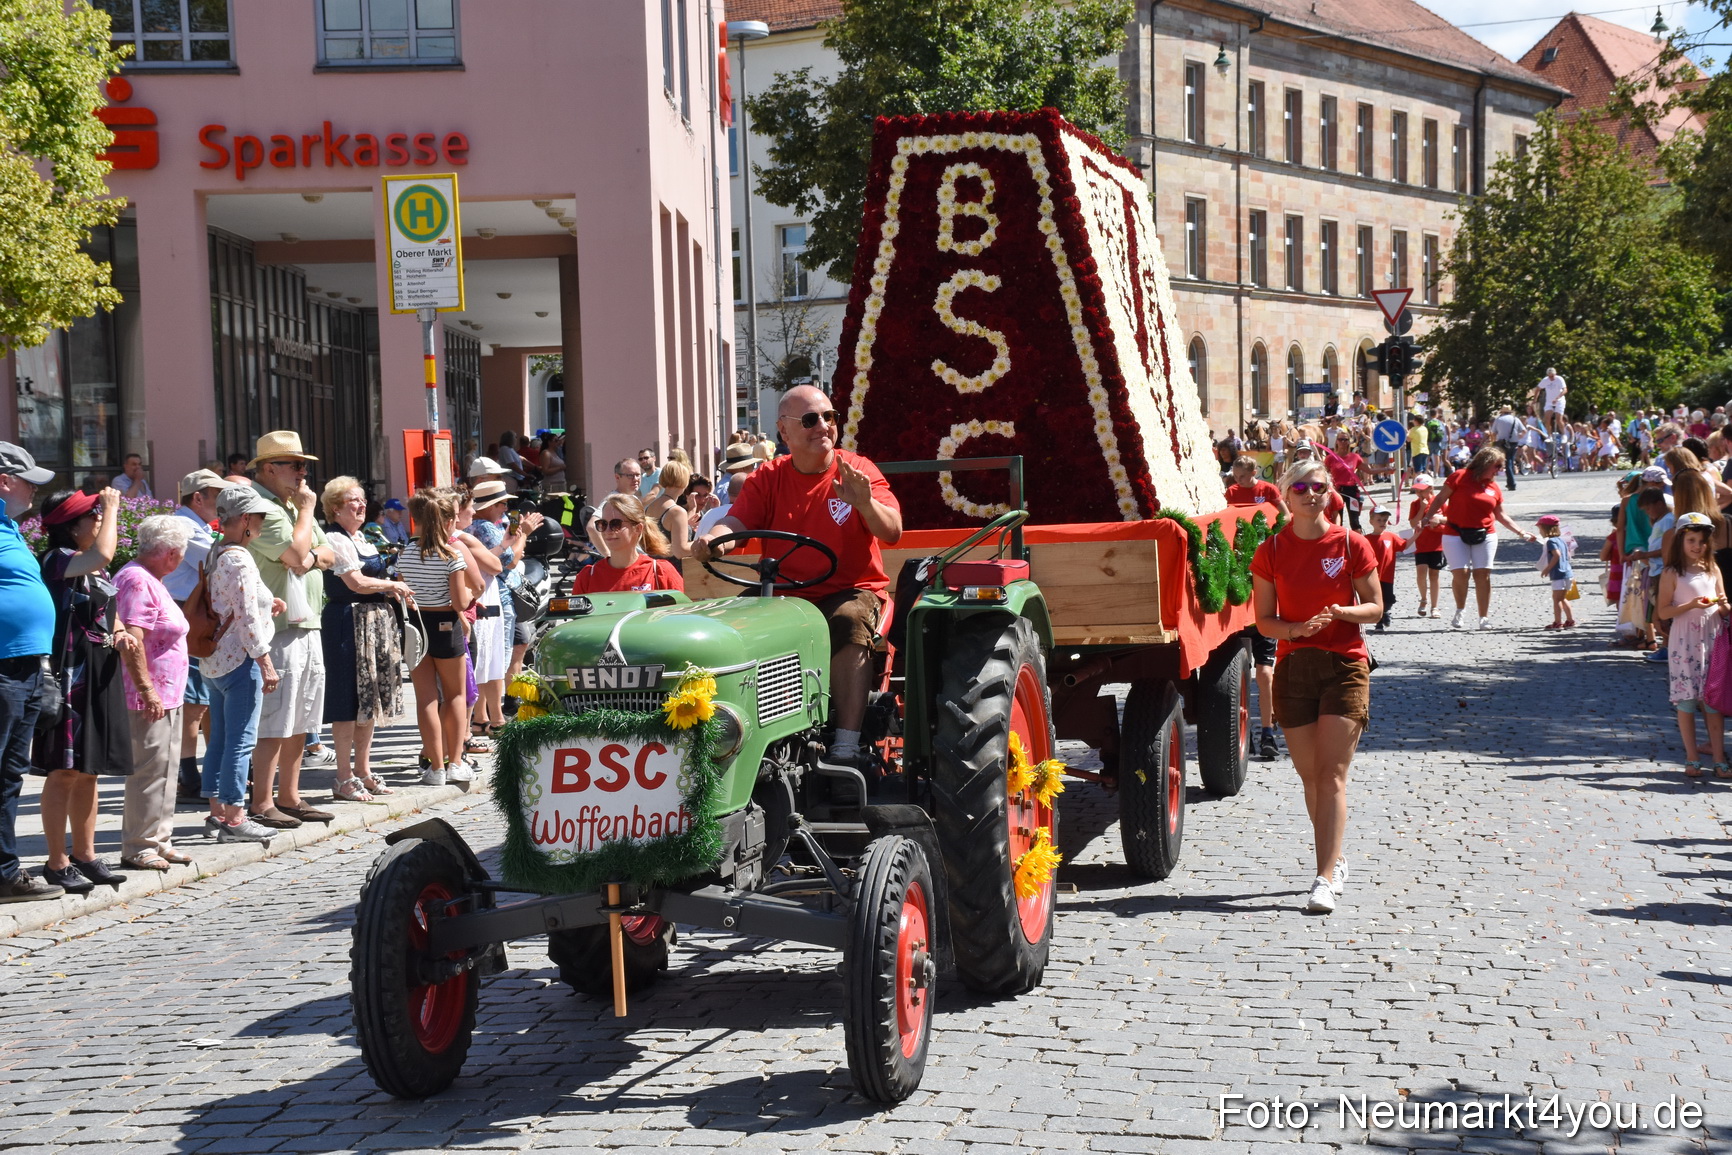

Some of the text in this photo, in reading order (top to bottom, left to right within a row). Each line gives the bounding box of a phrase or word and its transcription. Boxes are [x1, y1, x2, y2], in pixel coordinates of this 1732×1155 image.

[198, 120, 470, 181] Sparkasse
[408, 198, 435, 230] H
[395, 248, 452, 259] Oberer Markt
[566, 666, 663, 689] FENDT
[551, 742, 667, 793] BSC
[531, 804, 694, 851] Woffenbach
